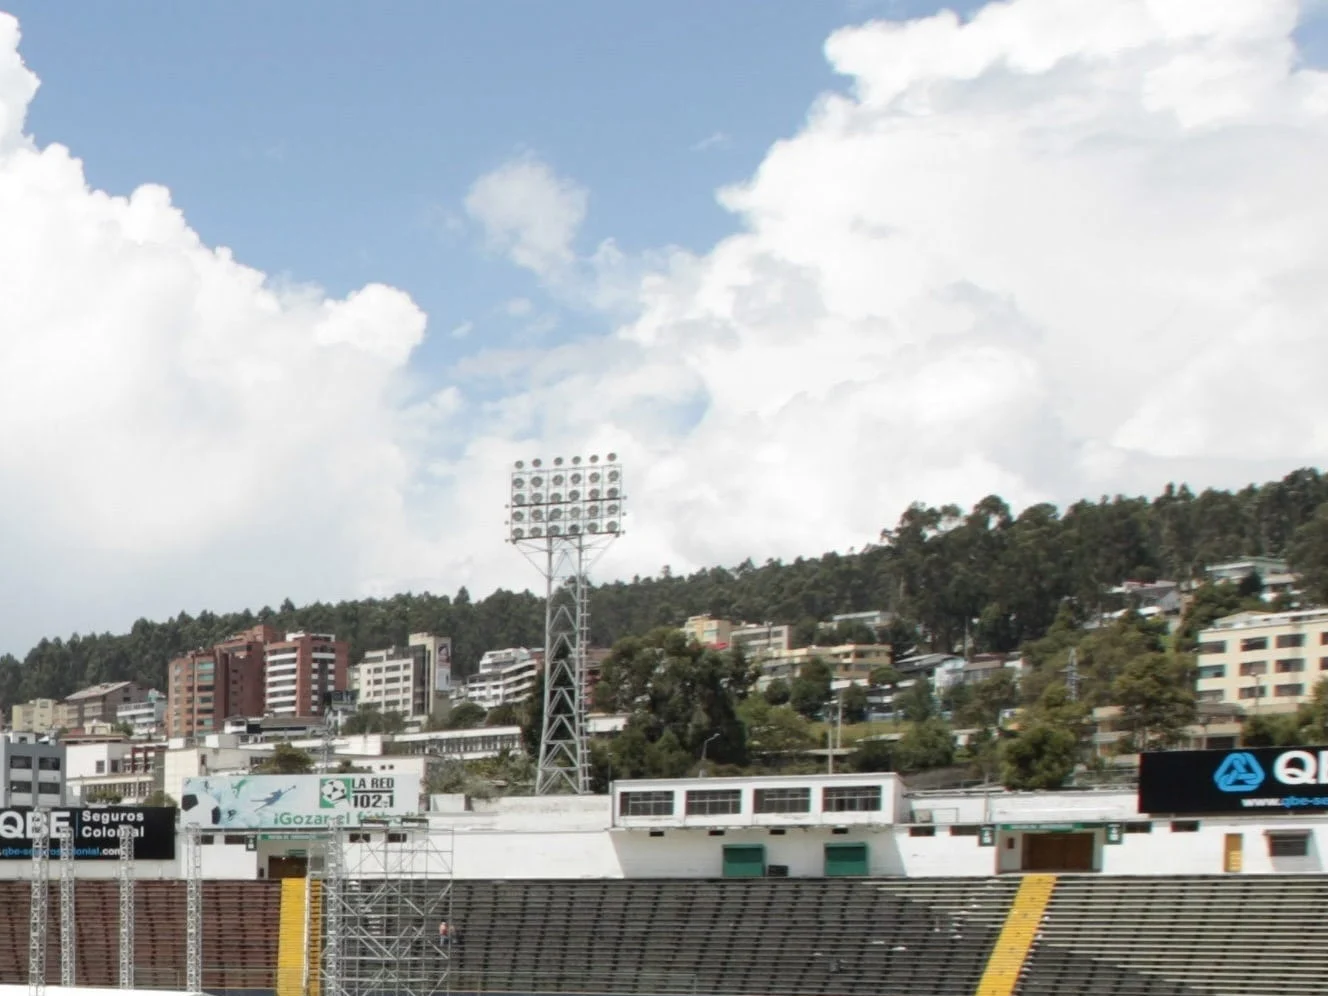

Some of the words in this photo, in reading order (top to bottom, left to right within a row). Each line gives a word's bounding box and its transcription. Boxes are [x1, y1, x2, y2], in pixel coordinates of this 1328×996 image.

[352, 777, 366, 788] LA
[371, 777, 394, 789] RED
[82, 811, 144, 824] Seguros
[82, 825, 144, 838] Colonal
